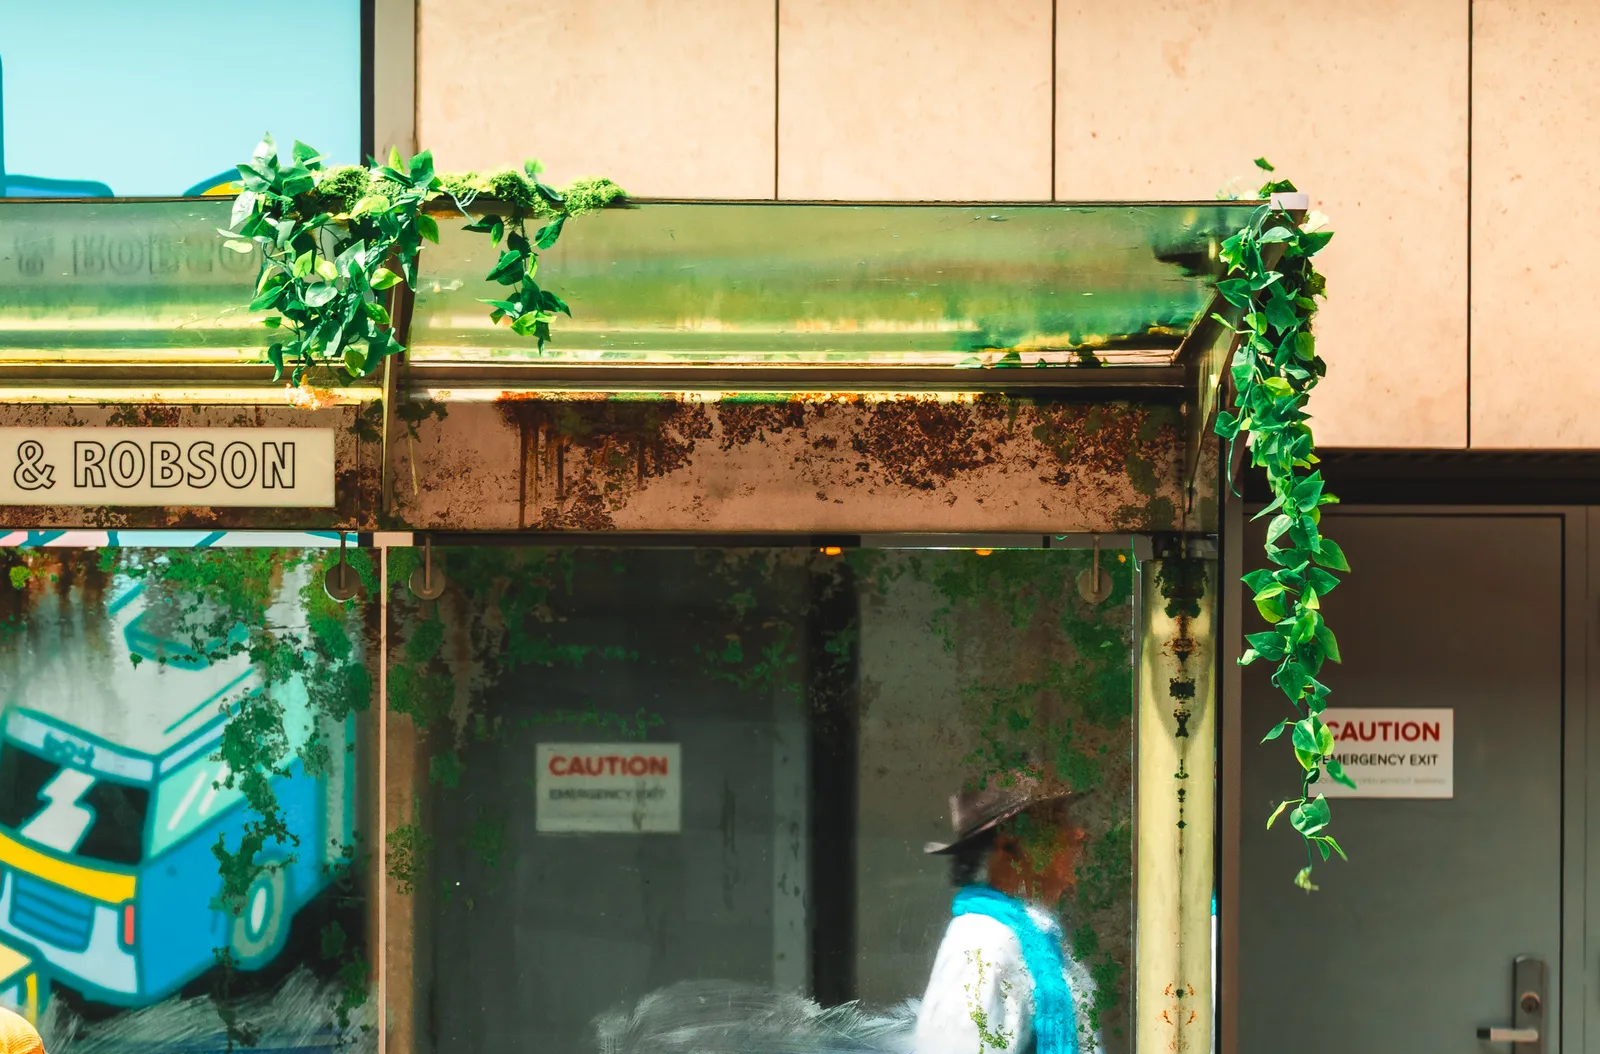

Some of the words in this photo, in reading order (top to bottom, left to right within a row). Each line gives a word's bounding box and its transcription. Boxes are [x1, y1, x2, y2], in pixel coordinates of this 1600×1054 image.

[14, 440, 56, 491] &
[74, 440, 296, 490] ROBSON
[549, 755, 668, 776] CAUTION
[1410, 754, 1438, 765] EXIT
